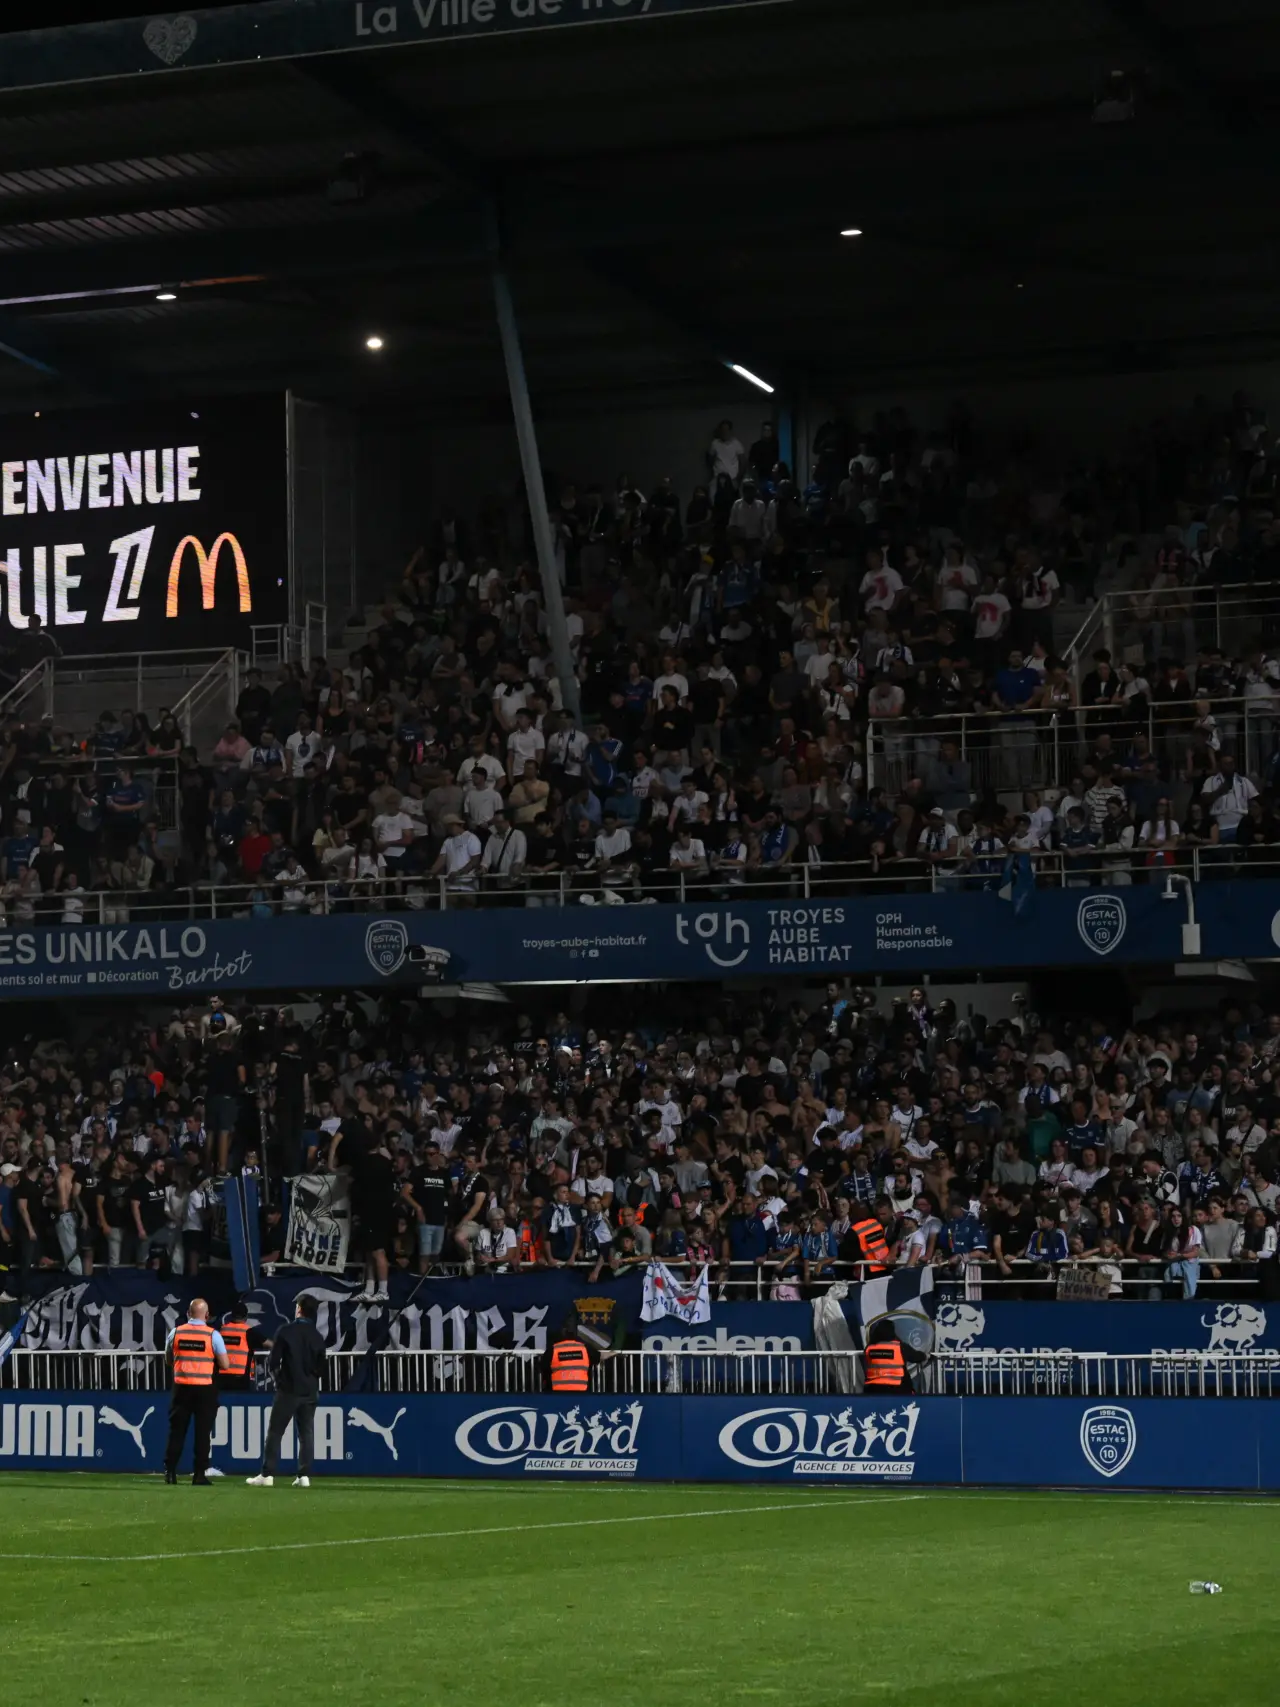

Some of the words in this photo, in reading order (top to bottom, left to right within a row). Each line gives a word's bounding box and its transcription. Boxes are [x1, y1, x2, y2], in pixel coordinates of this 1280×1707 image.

[356, 3, 397, 36] La
[412, 0, 495, 28] Ville
[768, 907, 845, 925] TROYES
[875, 913, 902, 924] OPH
[1086, 910, 1117, 919] ESTAC
[768, 928, 820, 944] AUBE
[875, 924, 922, 937] Humain
[924, 925, 938, 936] et
[46, 926, 206, 963] UNIKALO
[373, 935, 400, 943] ESTAC
[522, 935, 647, 949] troyes-aube-habitat.fr
[876, 936, 953, 950] Responsable
[768, 945, 852, 964] HABITAT
[166, 950, 253, 990] Barbot
[28, 972, 44, 986] sol
[46, 973, 57, 985] et
[59, 973, 82, 984] mur
[98, 969, 159, 983] Décoration
[1090, 1425, 1125, 1435] ESTAC
[1103, 1450, 1114, 1458] 10
[526, 1460, 566, 1469] AGENCE
[570, 1460, 583, 1469] DE
[588, 1460, 635, 1469] VOYAGES
[795, 1462, 837, 1471] AGENCE
[842, 1463, 856, 1472] DE
[862, 1463, 912, 1472] VOYAGES
